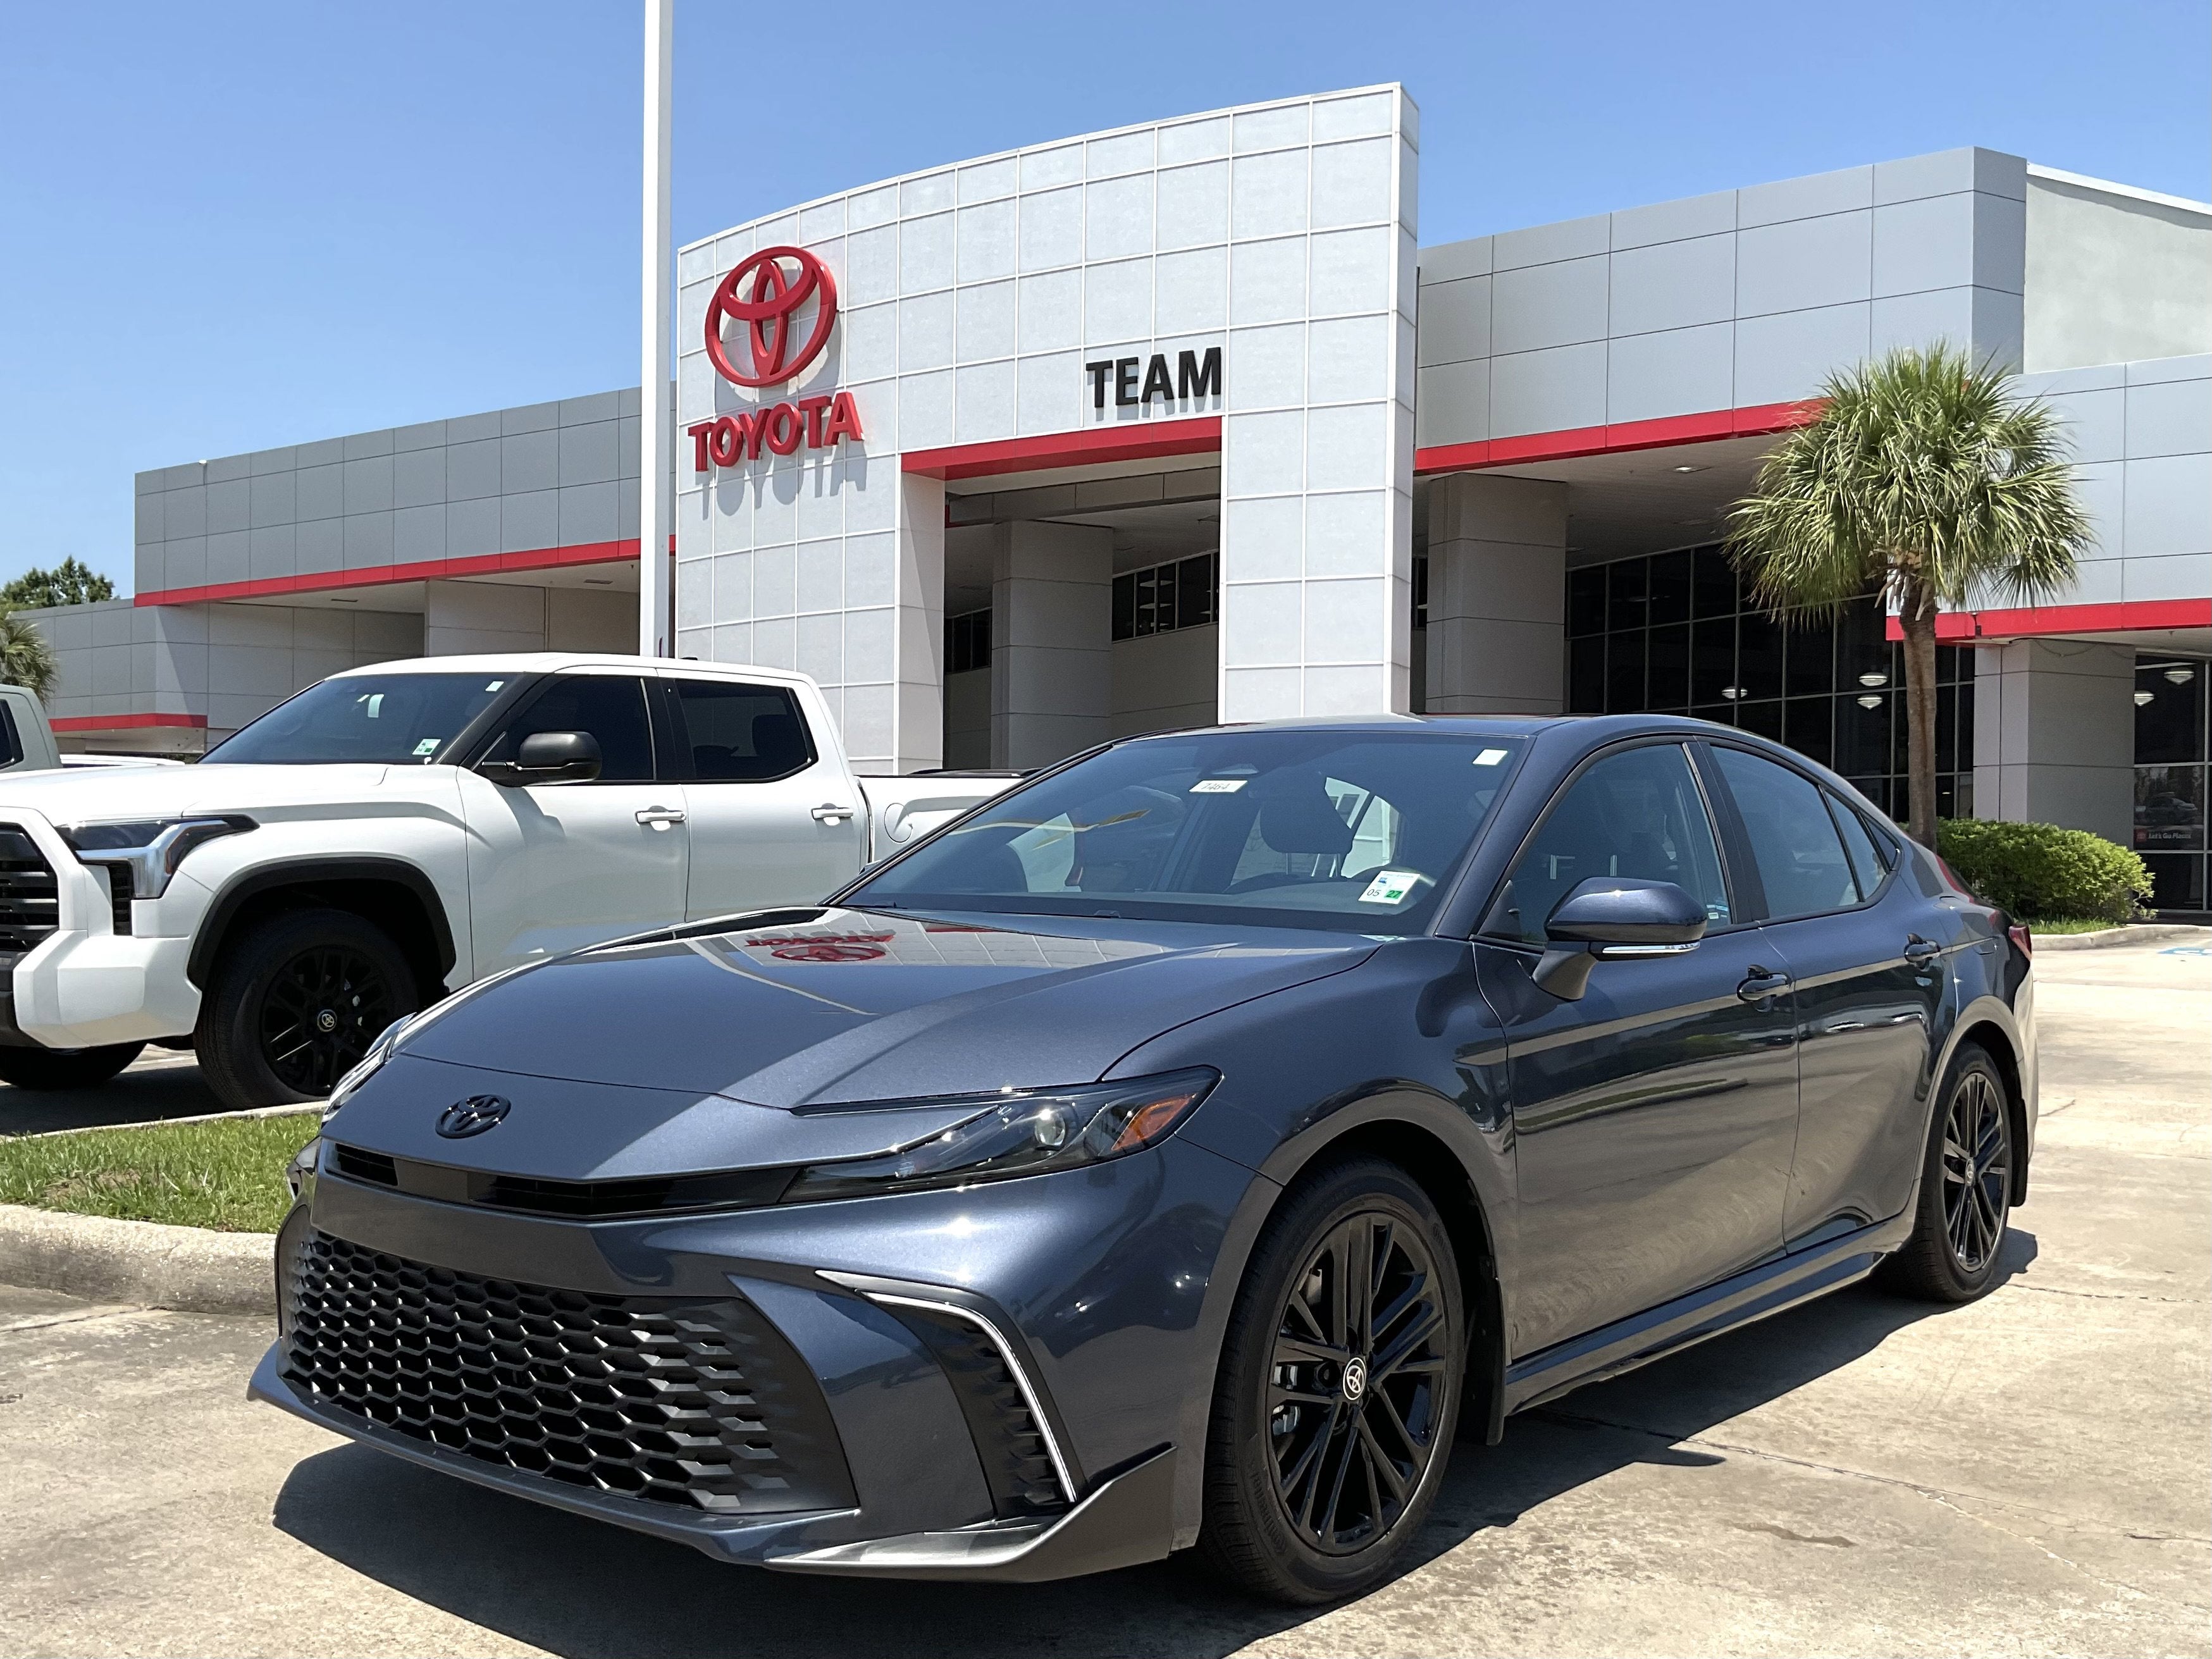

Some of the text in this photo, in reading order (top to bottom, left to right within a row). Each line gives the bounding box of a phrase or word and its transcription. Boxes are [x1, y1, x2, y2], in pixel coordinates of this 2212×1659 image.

[1085, 347, 1222, 408] TEAM
[688, 392, 865, 472] TOYOTA
[1367, 889, 1402, 898] 05 27
